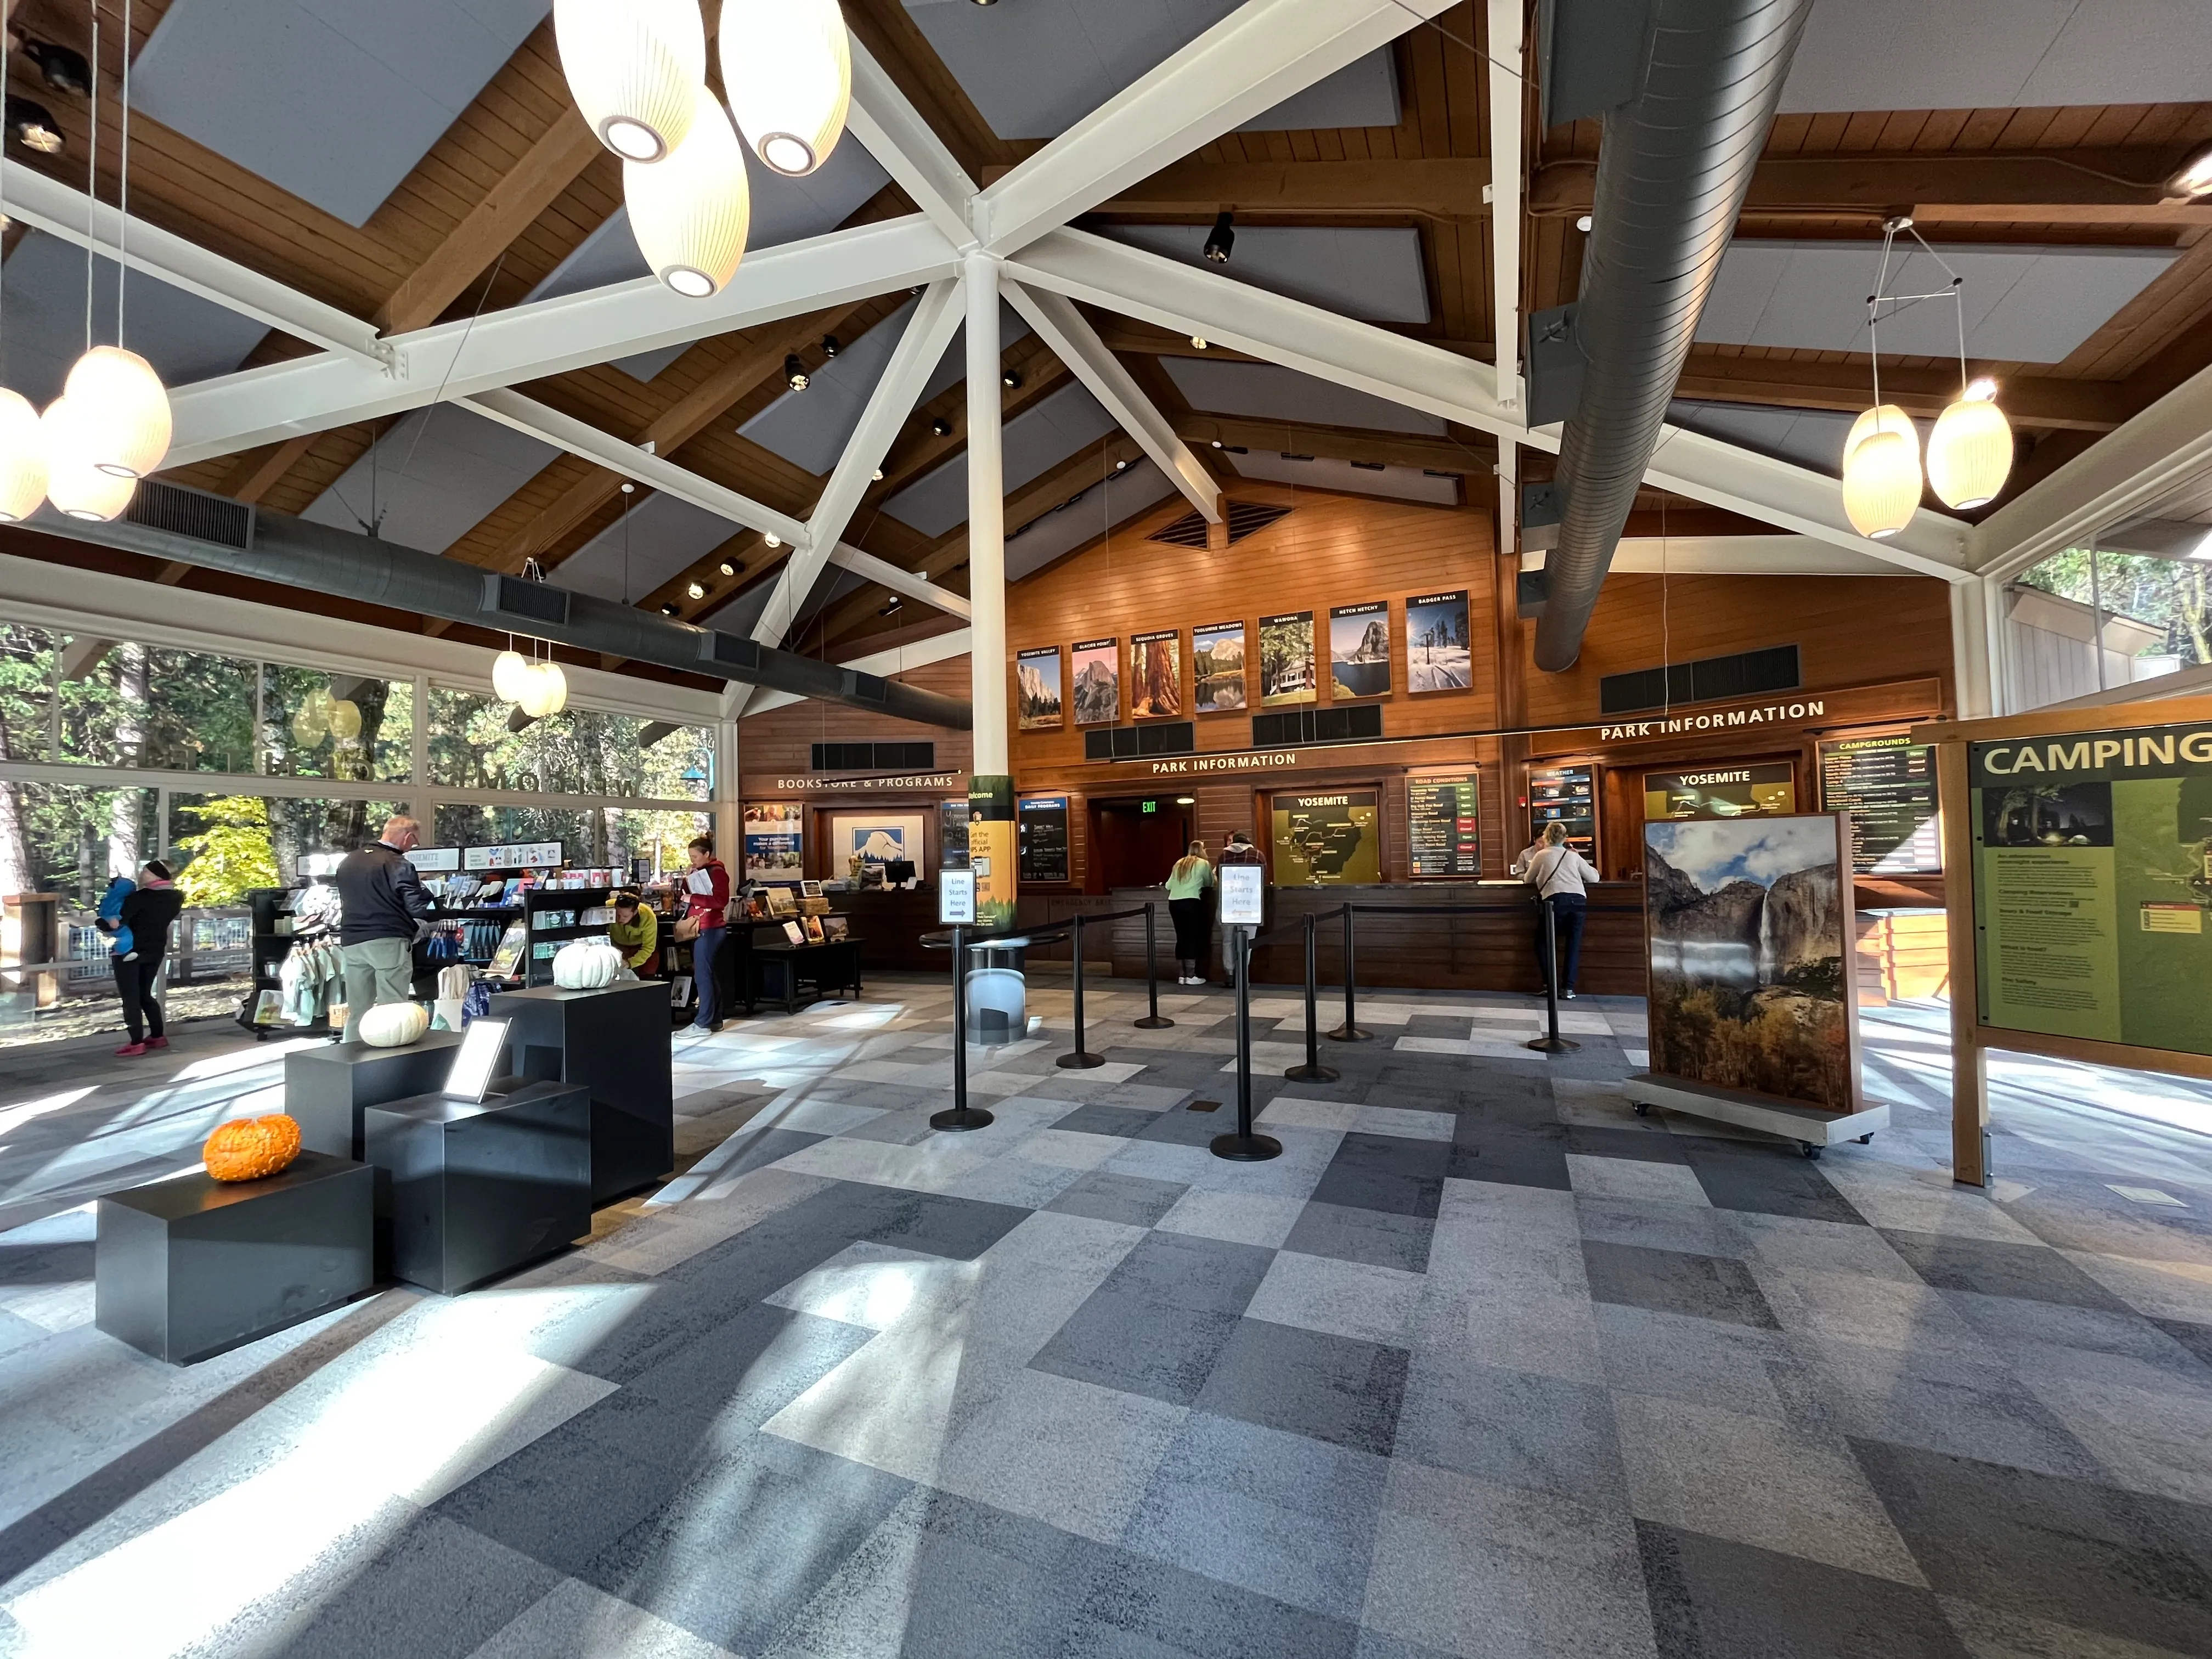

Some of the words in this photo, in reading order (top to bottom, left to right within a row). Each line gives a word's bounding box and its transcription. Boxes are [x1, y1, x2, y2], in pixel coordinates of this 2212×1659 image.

[1601, 723, 1650, 740] PARK
[1661, 701, 1824, 733] INFORMATION
[1839, 737, 1911, 750] CAMPGROUNDS
[1984, 732, 2212, 775] CAMPING
[1153, 761, 1187, 774] PARK
[1194, 753, 1295, 770] INFORMATION
[879, 777, 952, 787] PROGRAMS
[1679, 771, 1750, 786] YOSEMITE
[1143, 801, 1155, 812] EXIT
[1298, 796, 1348, 807] YOSEMITE
